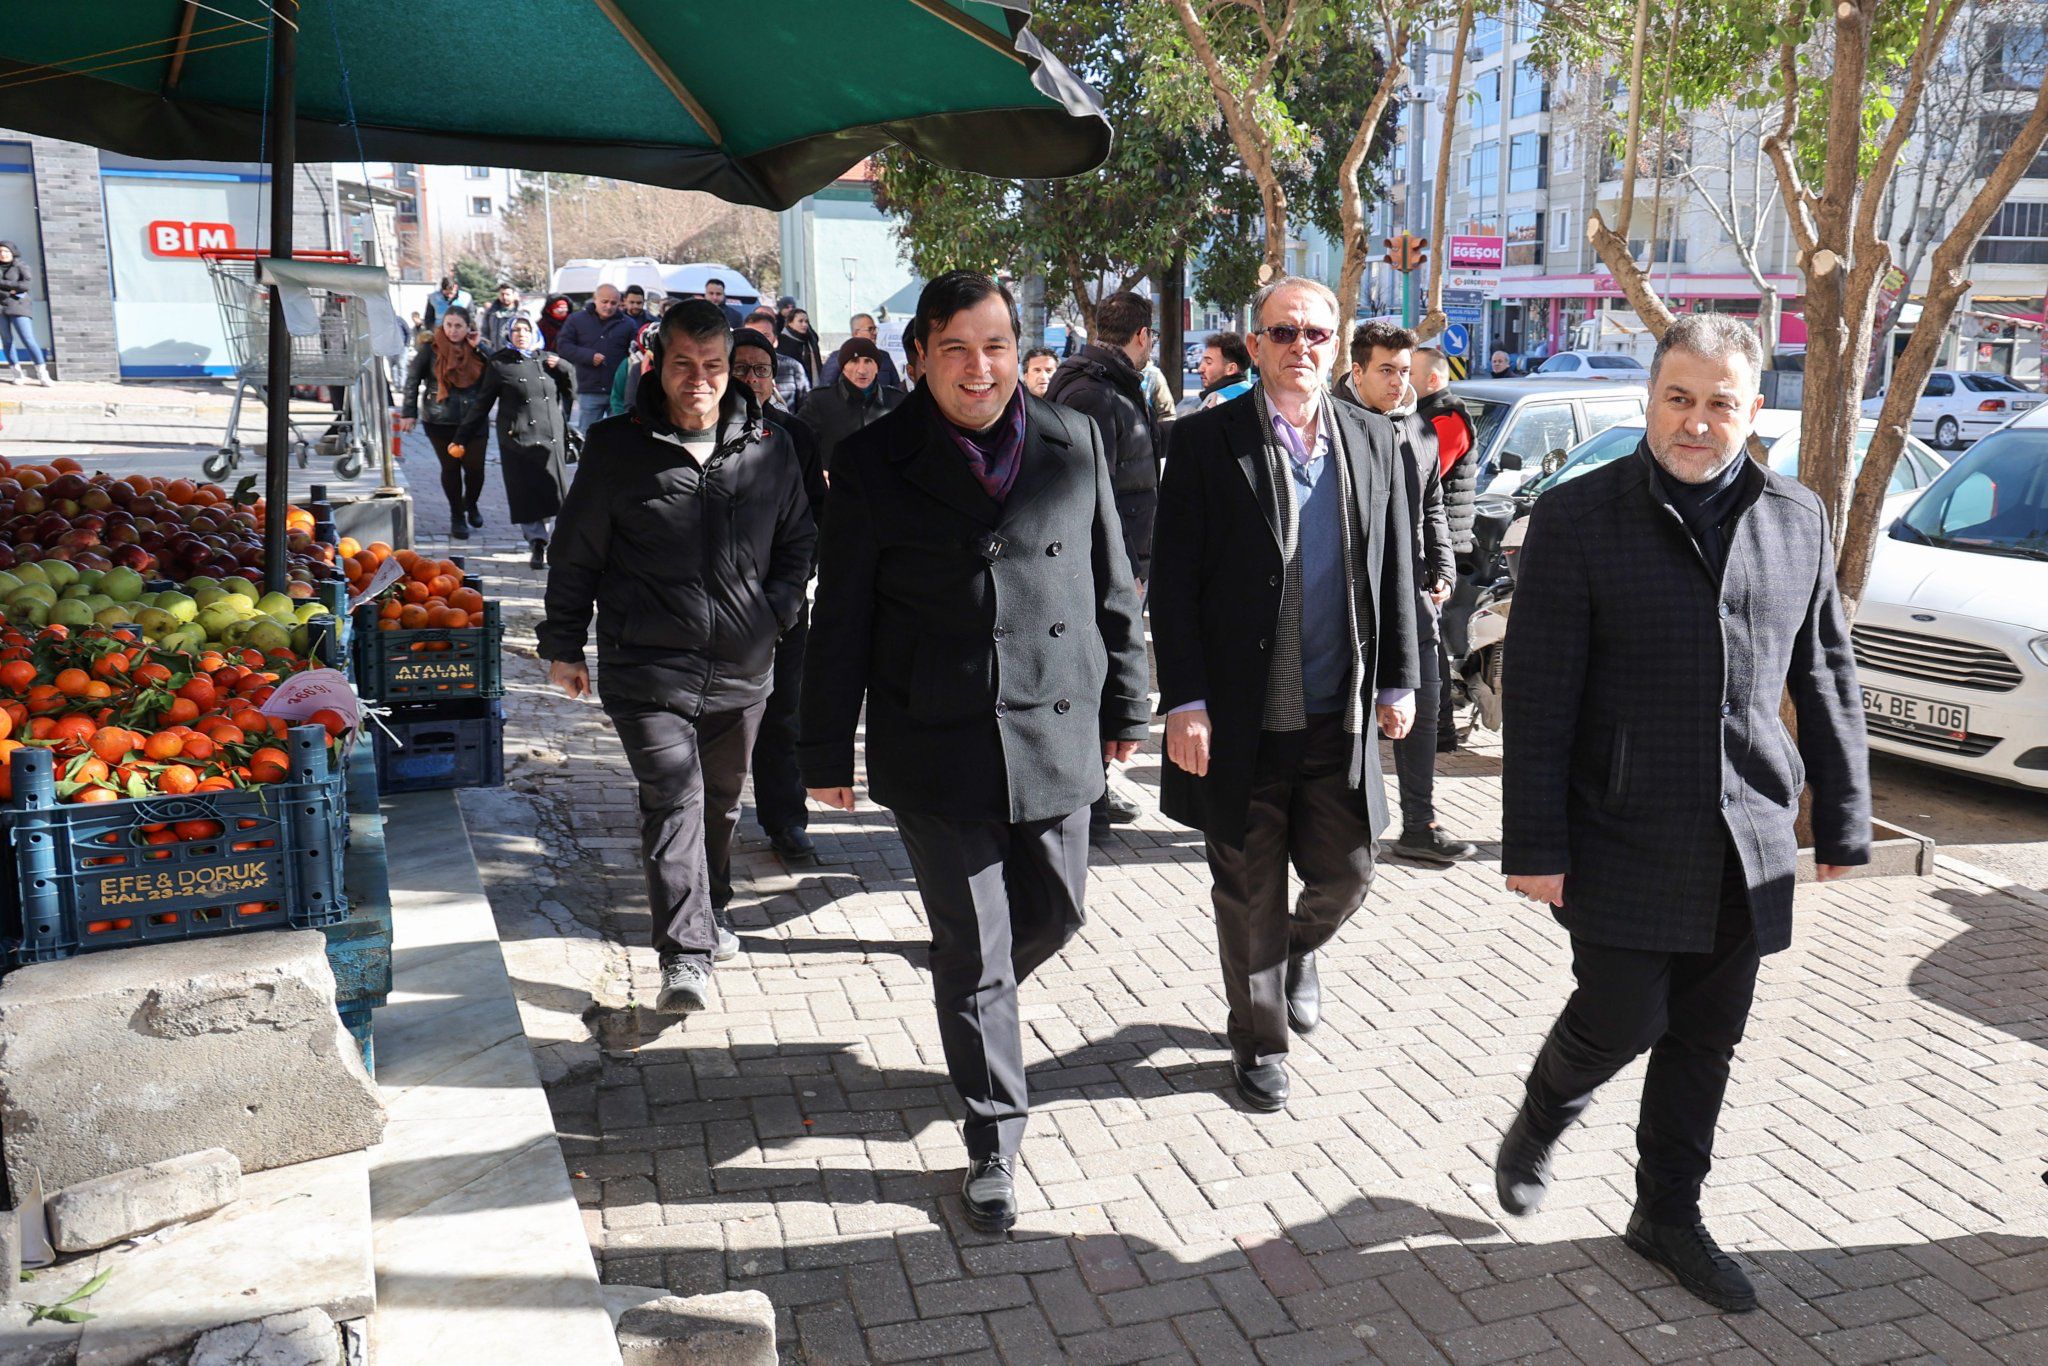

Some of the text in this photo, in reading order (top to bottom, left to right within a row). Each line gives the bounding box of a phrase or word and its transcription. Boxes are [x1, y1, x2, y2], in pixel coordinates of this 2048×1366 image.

[1453, 246, 1501, 260] EGEŞOK
[399, 664, 470, 674] ATALAN
[1862, 691, 1883, 713] 64
[1890, 697, 1918, 720] BE
[1928, 704, 1963, 729] 106
[101, 861, 268, 895] EFE & DORUK
[101, 892, 144, 906] HAL
